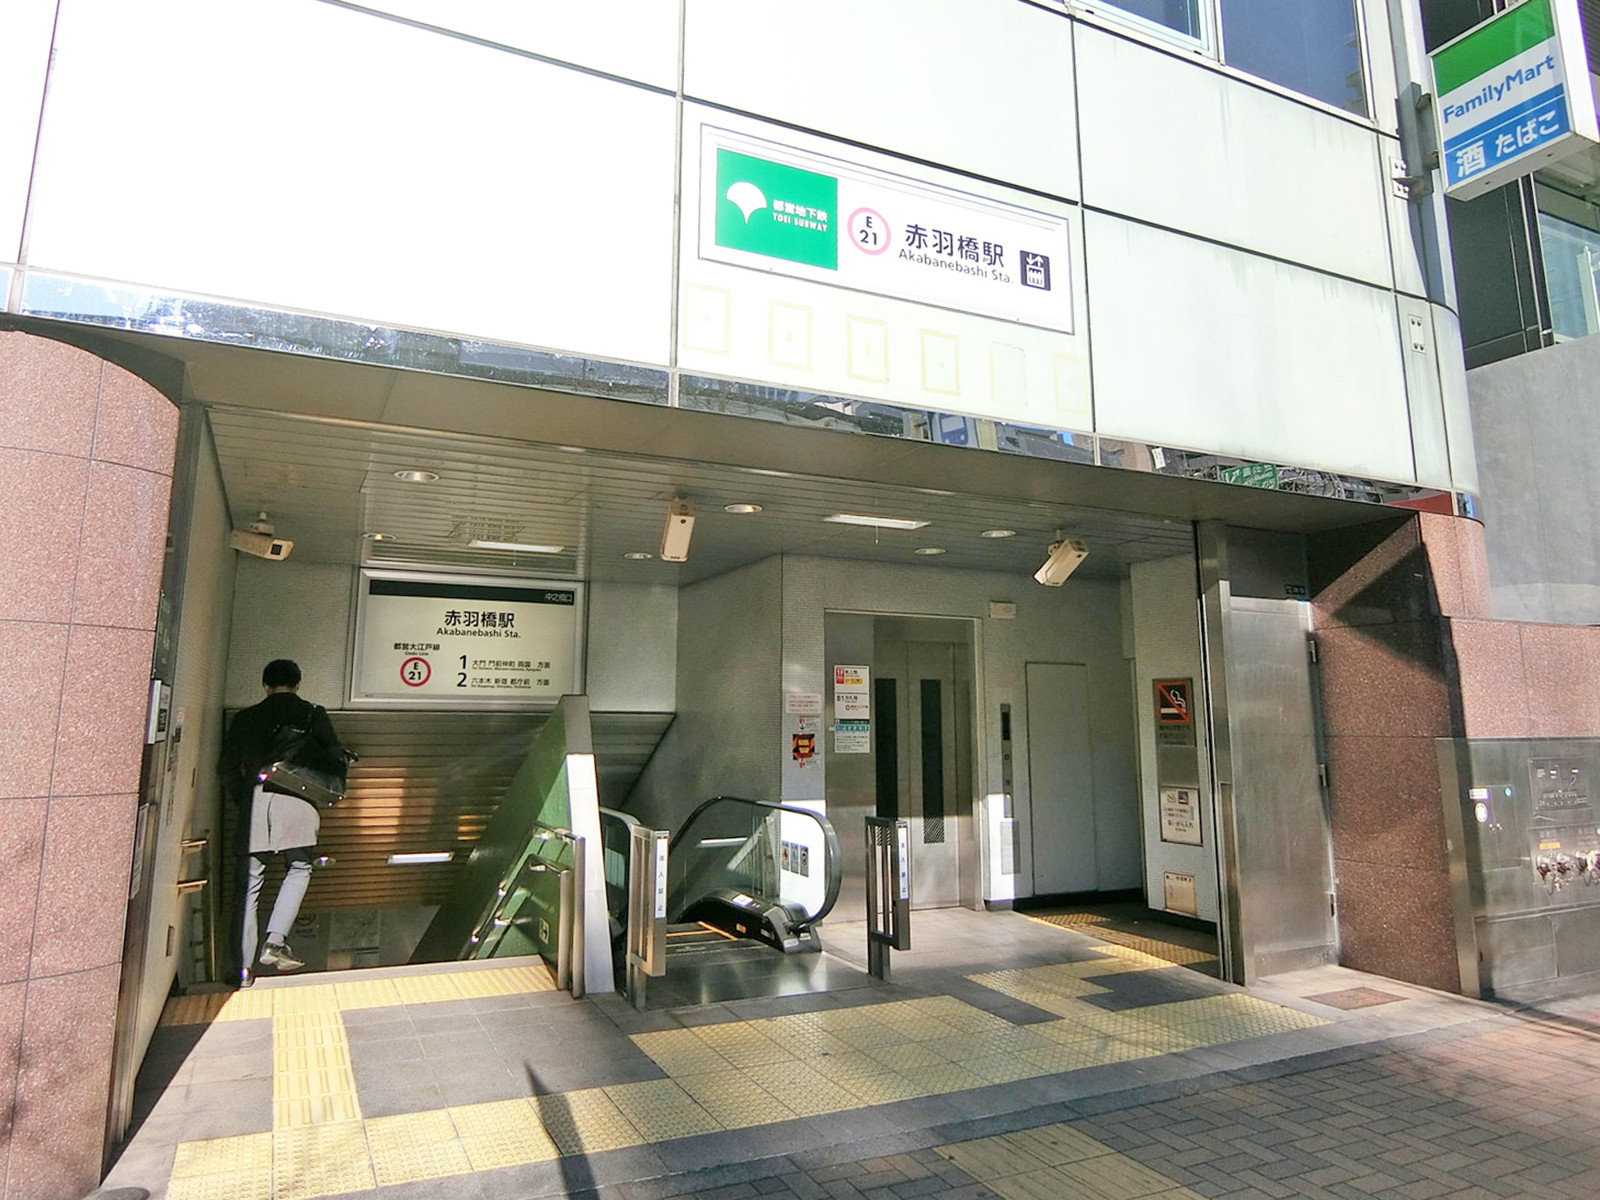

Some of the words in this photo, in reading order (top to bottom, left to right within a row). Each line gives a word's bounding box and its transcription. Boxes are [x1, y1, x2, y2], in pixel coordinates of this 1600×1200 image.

[1443, 54, 1555, 124] FamilyMart
[1456, 140, 1486, 177] 酒
[1495, 110, 1559, 157] たばこ
[773, 200, 828, 223] 都営地下鉄
[773, 212, 791, 224] TOEI
[794, 217, 828, 232] SUBWAY
[866, 216, 873, 228] E
[859, 229, 877, 246] 21
[905, 224, 1004, 267] 赤羽橋駅
[898, 248, 988, 278] Akabanebashi
[991, 269, 1014, 284] Sta.
[444, 610, 515, 629] 赤羽橋駅
[436, 627, 502, 638] Akabanebashi
[504, 629, 522, 639] Sta.
[394, 642, 440, 651] 都営大江戸線
[413, 662, 419, 670] E
[459, 655, 467, 669] 1
[408, 671, 422, 680] 21
[457, 672, 467, 687] 2
